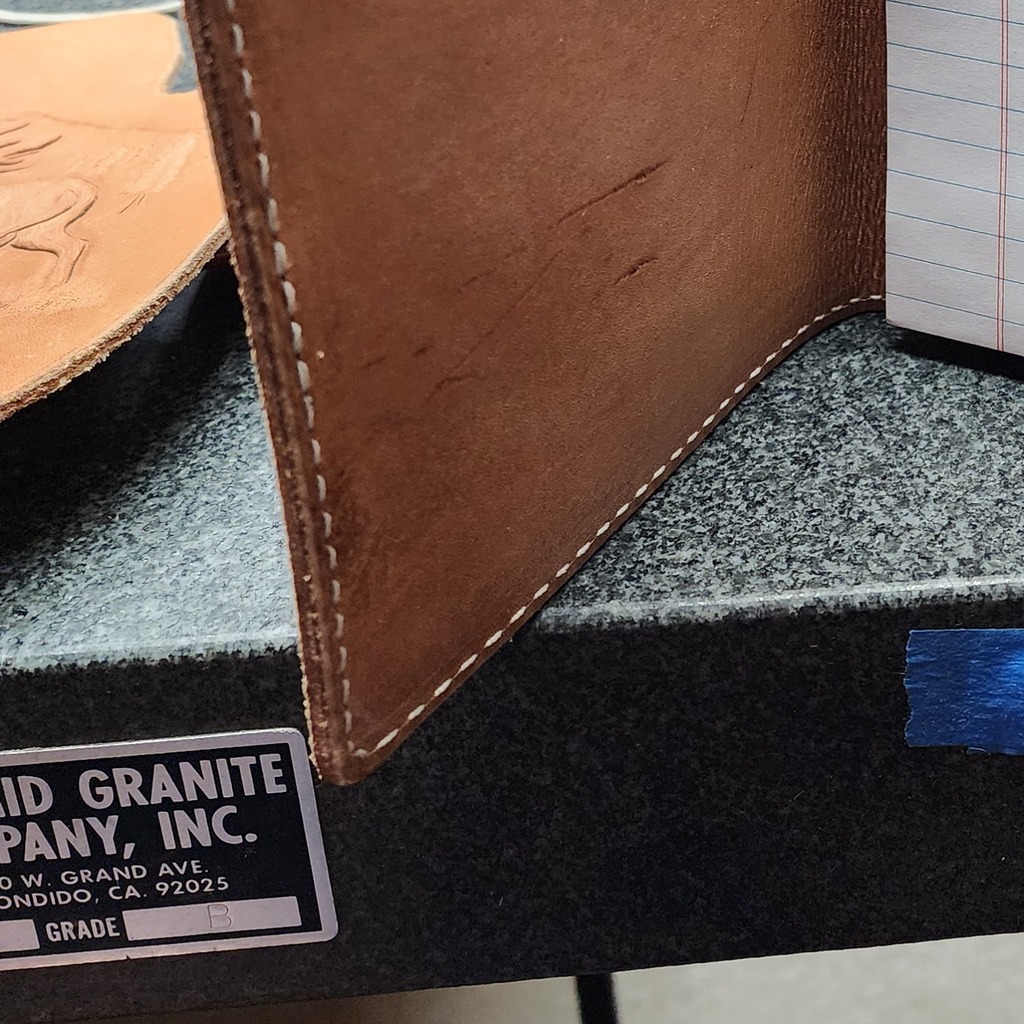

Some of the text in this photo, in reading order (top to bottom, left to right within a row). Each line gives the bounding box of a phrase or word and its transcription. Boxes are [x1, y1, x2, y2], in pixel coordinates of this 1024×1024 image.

[0, 753, 287, 817] ID GRANITE
[0, 805, 258, 864] PANY, INC.
[20, 873, 52, 888] W.
[60, 864, 148, 885] GRAND
[158, 860, 209, 877] AVE.
[108, 885, 147, 900] CA.
[155, 876, 230, 896] 92025
[45, 903, 233, 942] GRADE B
